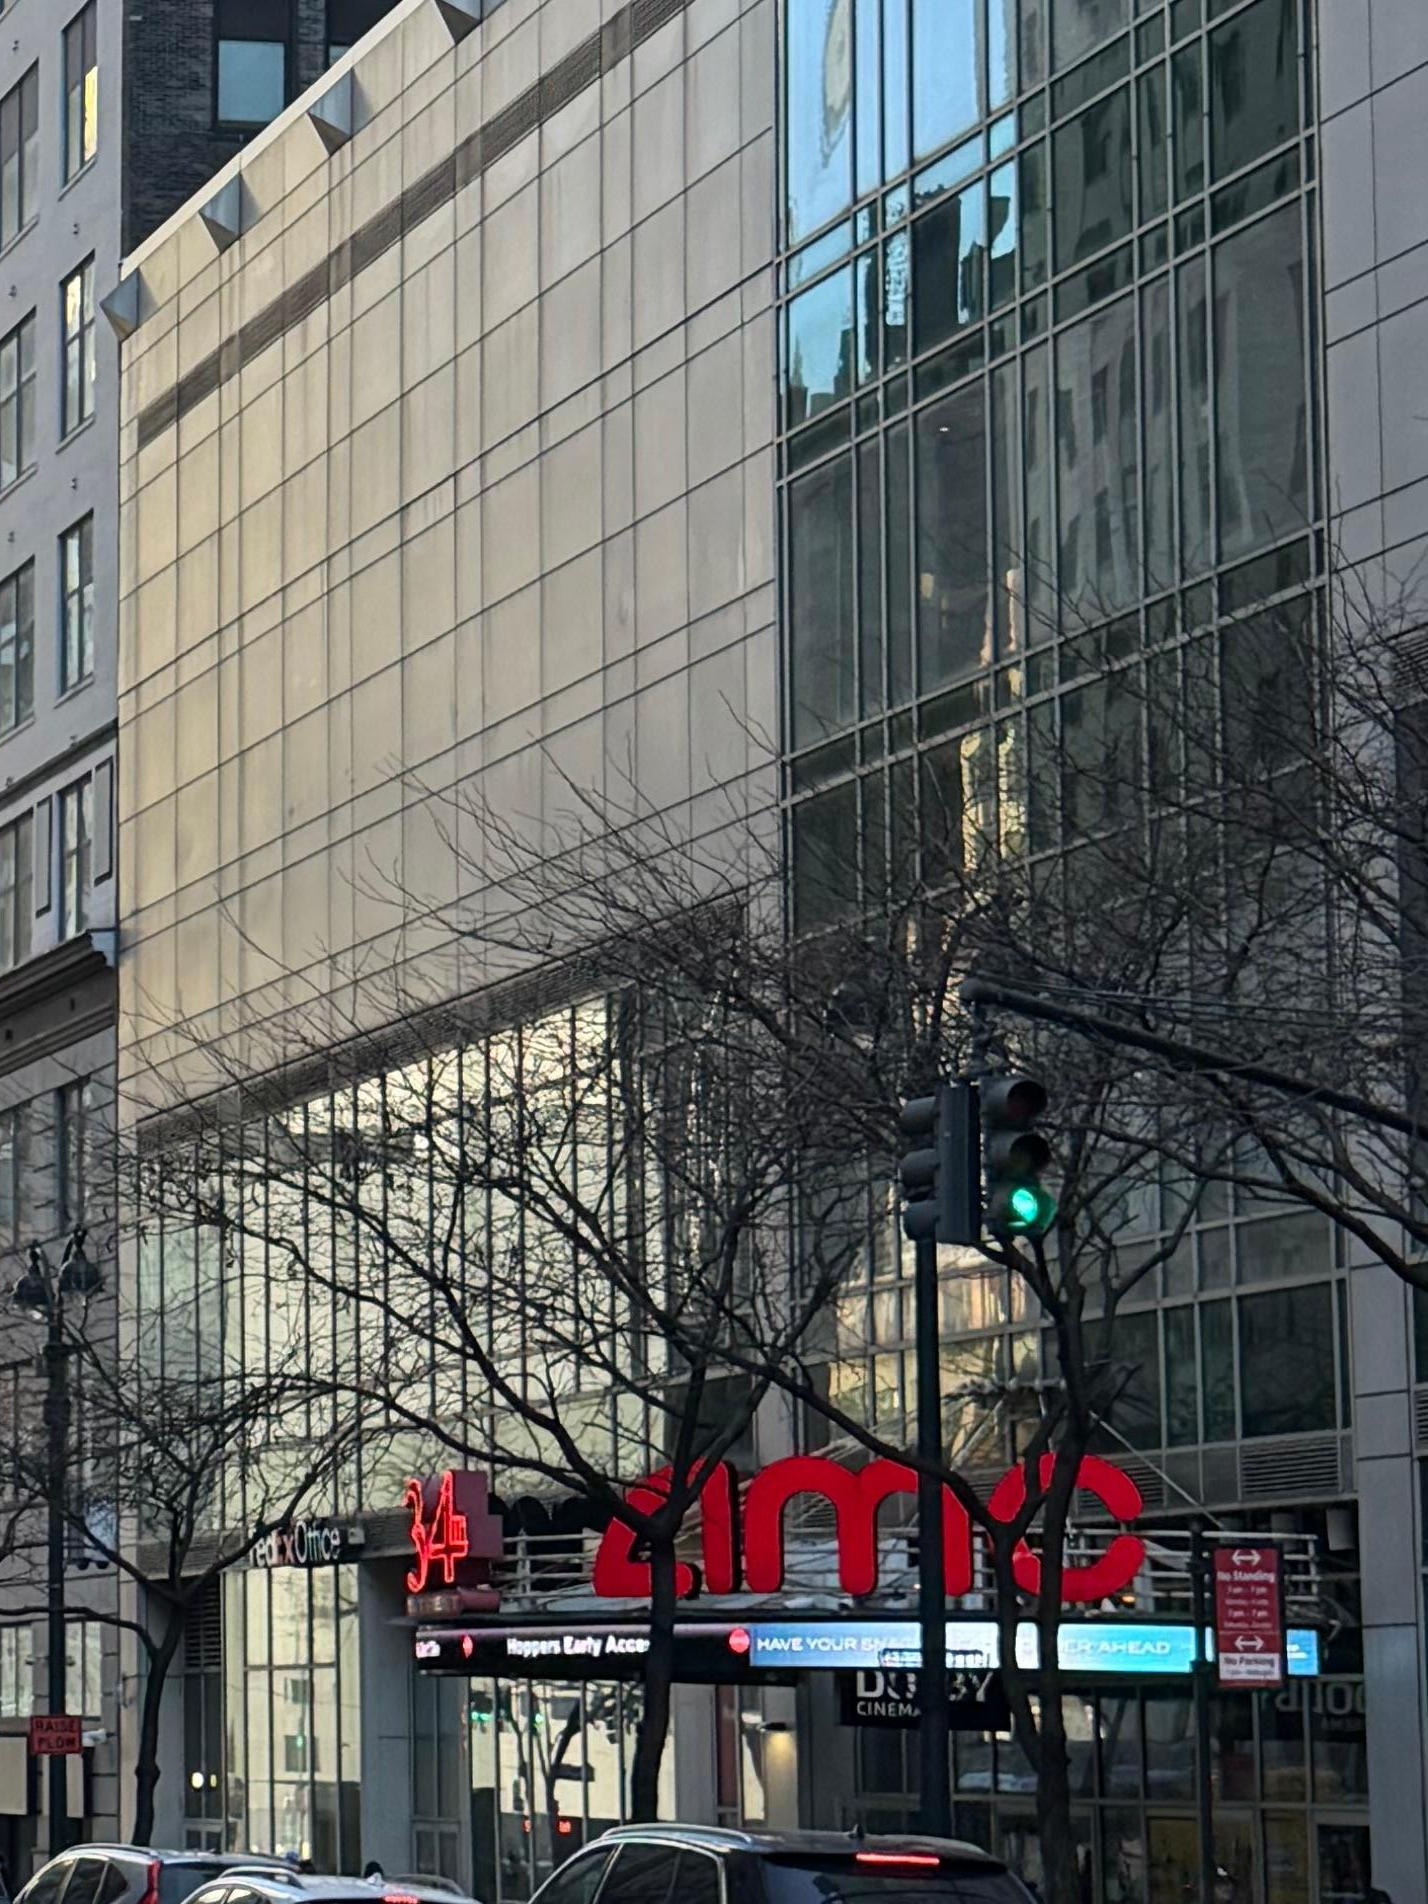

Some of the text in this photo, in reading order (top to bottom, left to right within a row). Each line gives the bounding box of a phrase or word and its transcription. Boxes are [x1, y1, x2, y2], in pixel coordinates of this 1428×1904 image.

[1216, 1571, 1276, 1583] No Standing
[506, 1637, 561, 1657] Hoppers
[562, 1635, 602, 1657] Early
[756, 1637, 803, 1652] HAVE
[806, 1637, 857, 1652] YOUR
[1098, 1639, 1172, 1656] AHEAD
